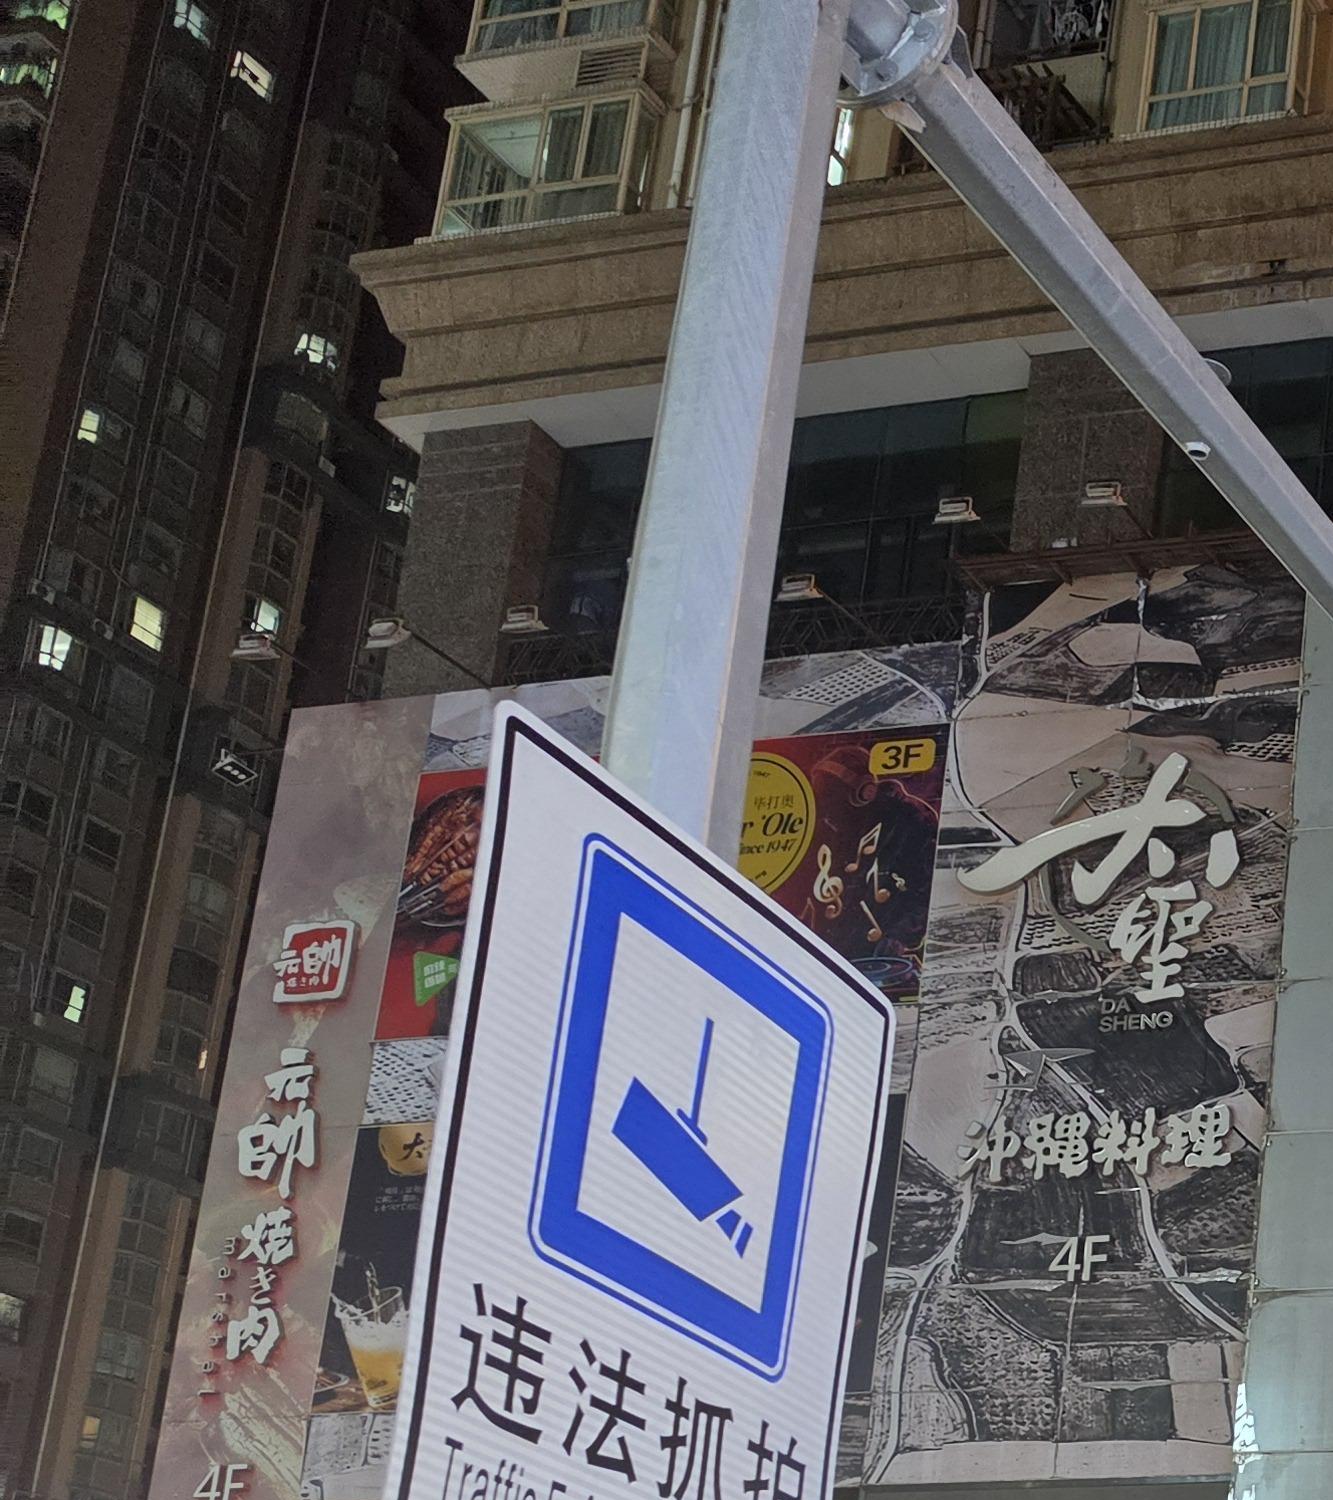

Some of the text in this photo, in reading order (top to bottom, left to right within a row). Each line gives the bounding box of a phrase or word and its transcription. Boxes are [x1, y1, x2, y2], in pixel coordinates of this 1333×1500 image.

[881, 744, 924, 770] 3F
[1101, 998, 1129, 1014] DA
[1099, 1011, 1174, 1034] SHENG
[1047, 1234, 1111, 1283] 4F
